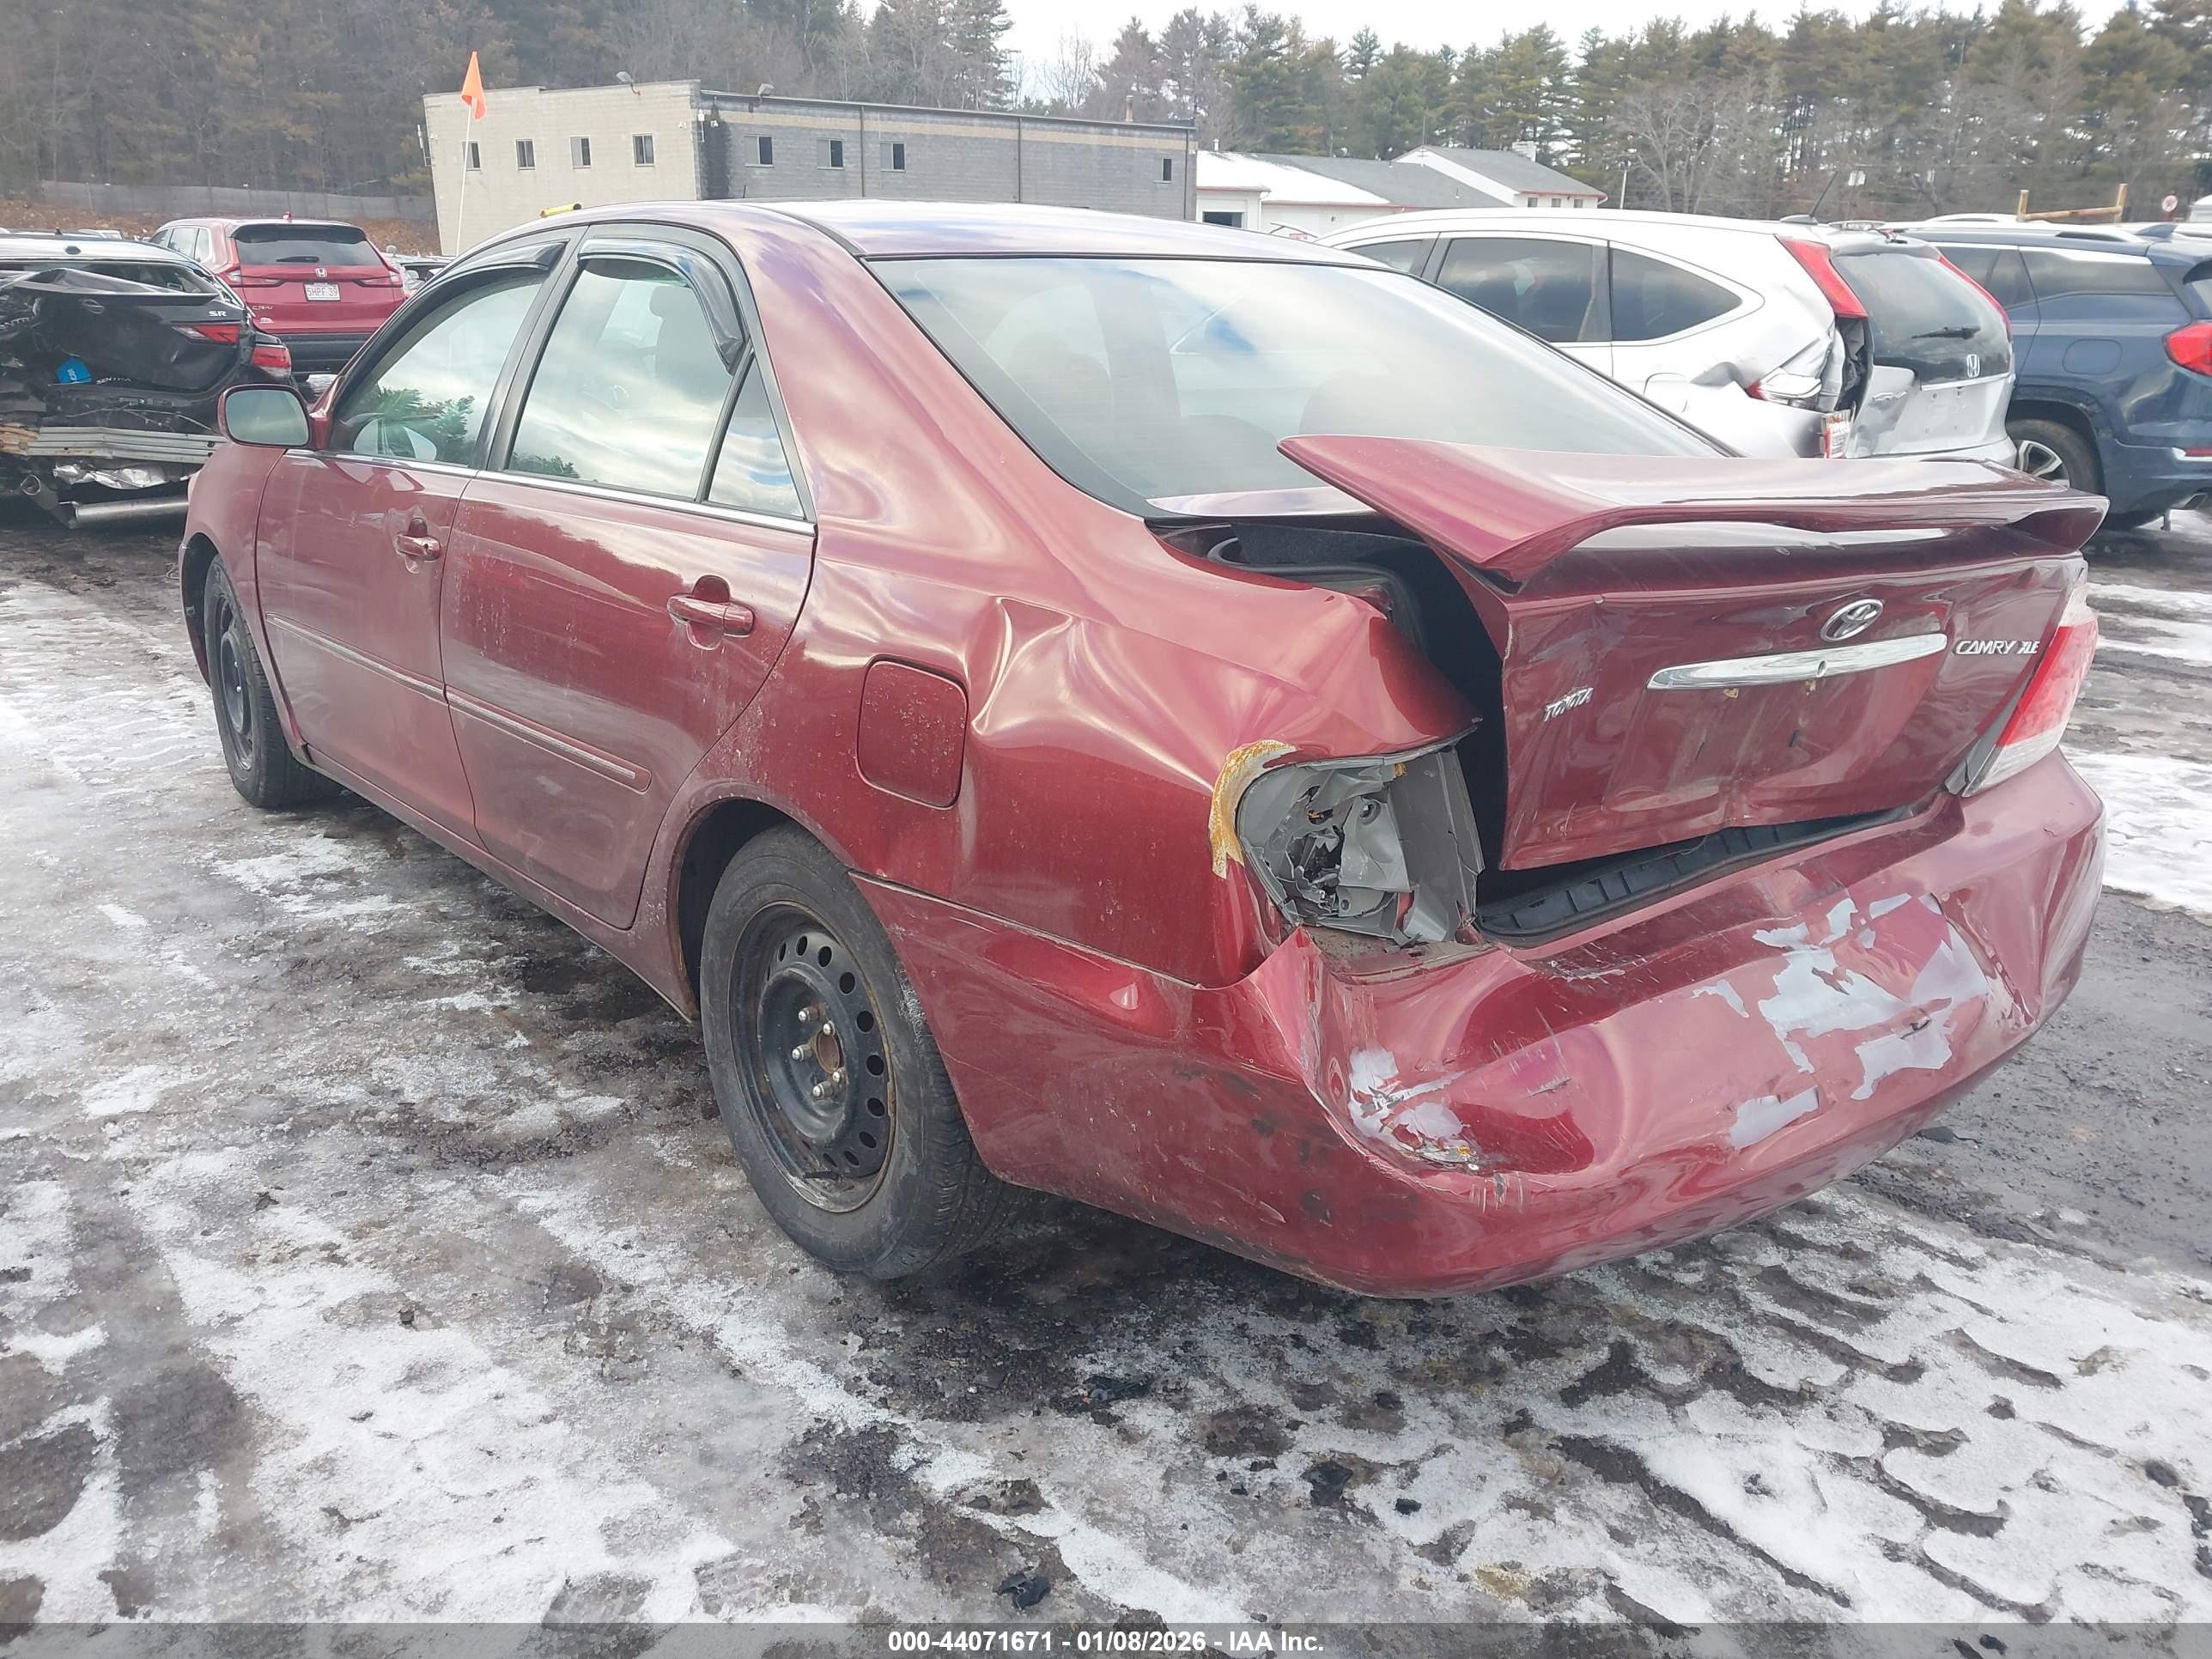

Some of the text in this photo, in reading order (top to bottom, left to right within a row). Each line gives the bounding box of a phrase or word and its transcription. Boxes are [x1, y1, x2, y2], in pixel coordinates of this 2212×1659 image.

[1955, 639, 2041, 655] CAMRY XLE
[1543, 687, 1595, 722] TOYOTA
